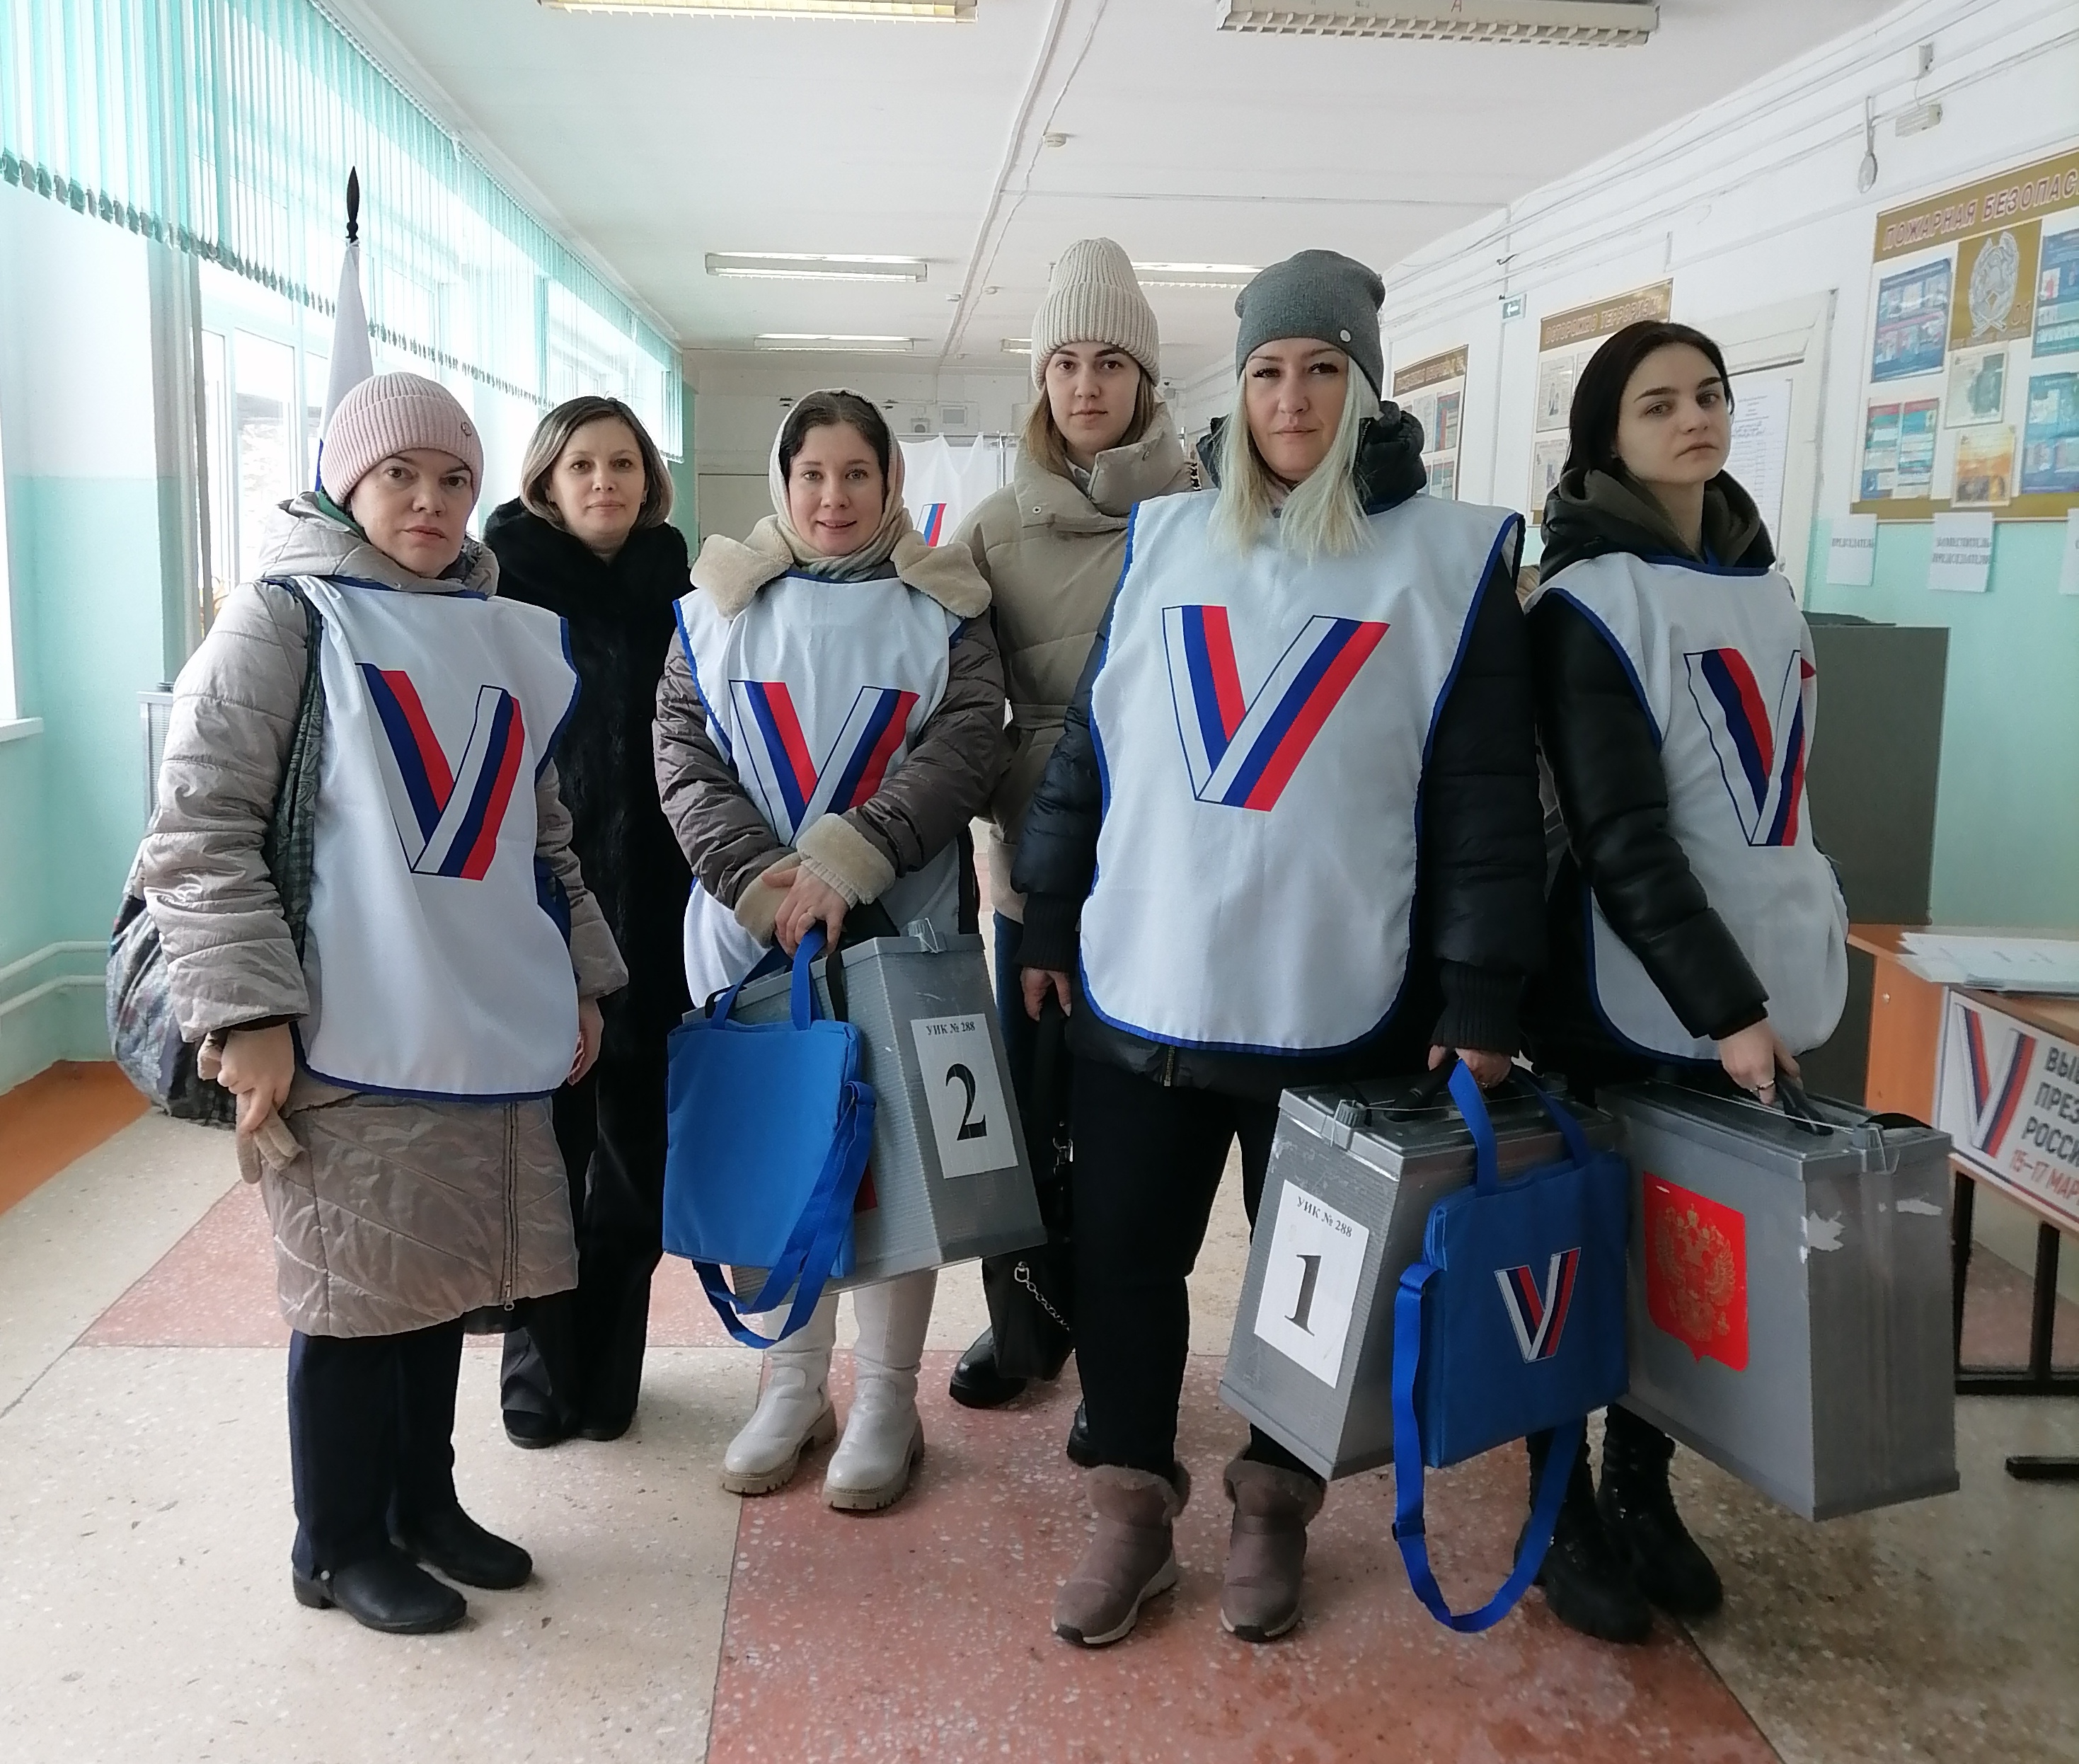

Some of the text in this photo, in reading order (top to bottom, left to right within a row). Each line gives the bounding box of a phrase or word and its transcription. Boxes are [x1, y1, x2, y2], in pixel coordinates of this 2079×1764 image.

[1882, 168, 2078, 250] ПОЖАРНАЯ БЕЗОПАС
[926, 1021, 976, 1036] УИК № 288
[2044, 1047, 2078, 1084] ВЫ
[945, 1063, 987, 1141] 2
[1296, 1196, 1353, 1238] УИК № 288
[1284, 1254, 1322, 1337] 1
